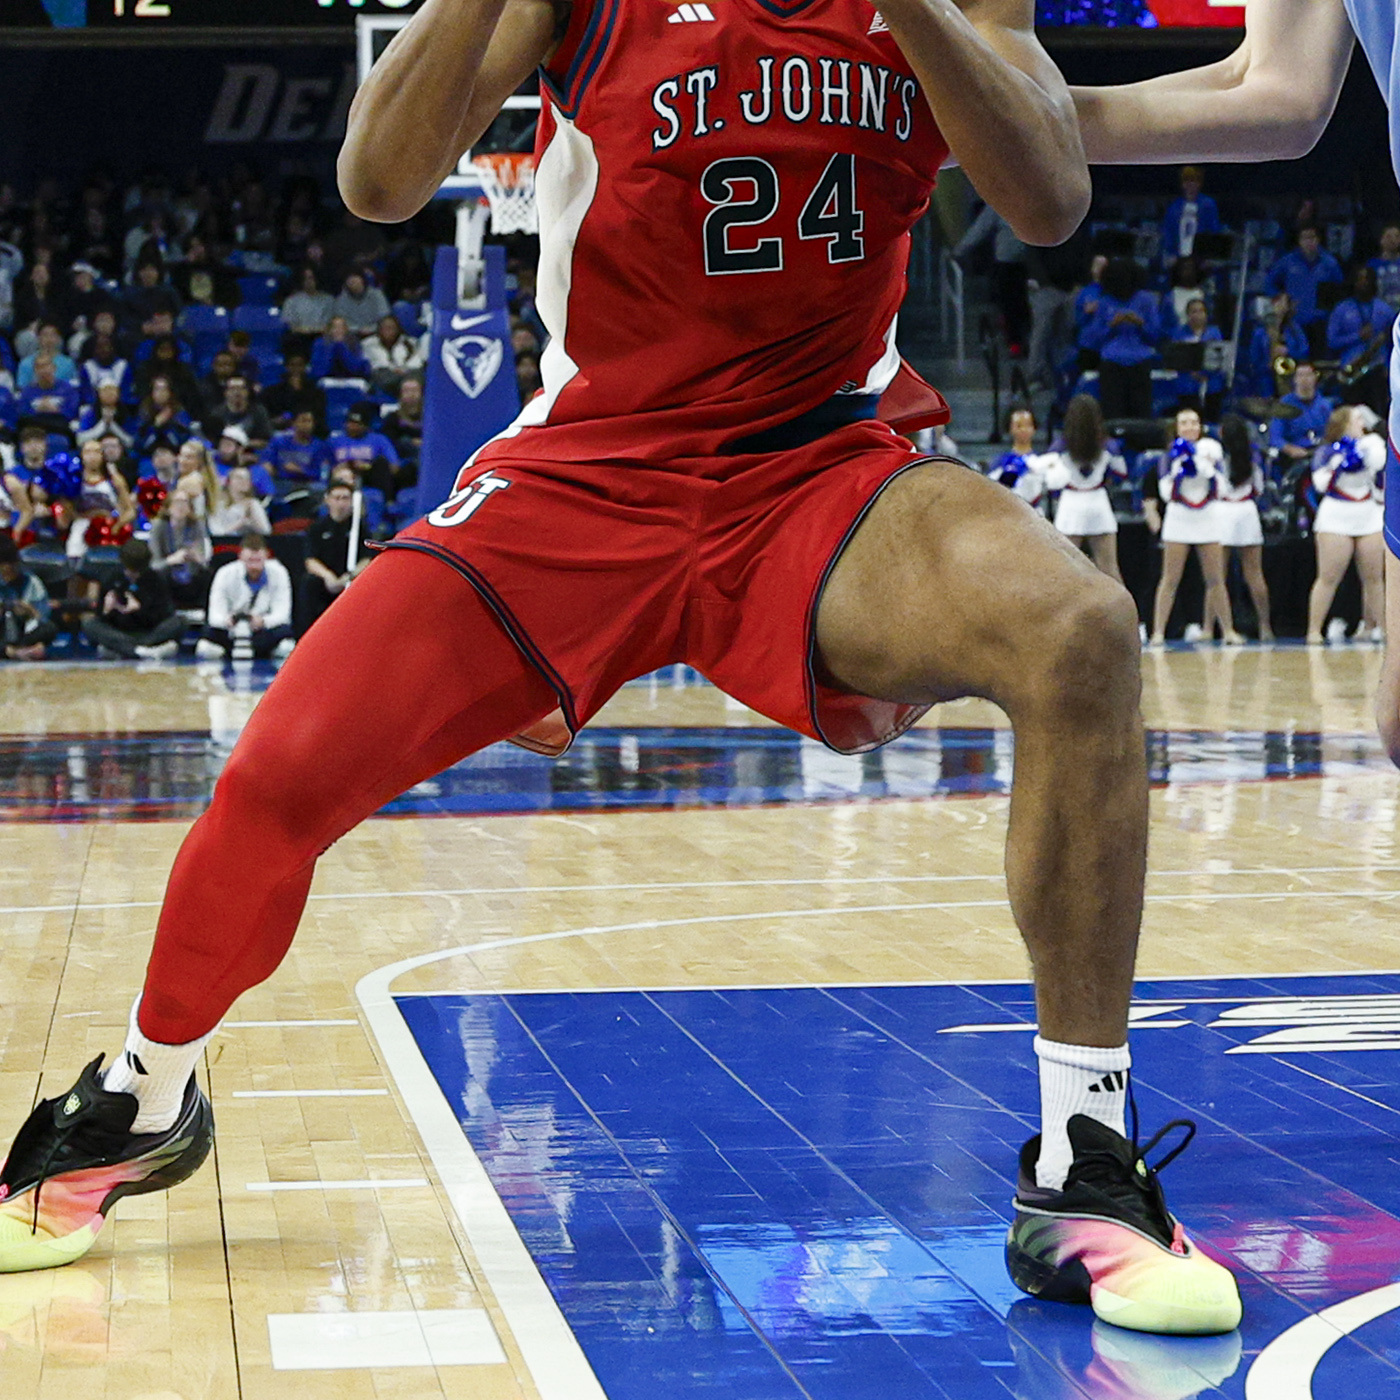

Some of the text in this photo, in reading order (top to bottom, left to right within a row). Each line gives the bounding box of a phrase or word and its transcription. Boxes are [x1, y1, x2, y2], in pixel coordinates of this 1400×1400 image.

[652, 54, 917, 151] ST. JOHN'S
[700, 151, 864, 277] 24
